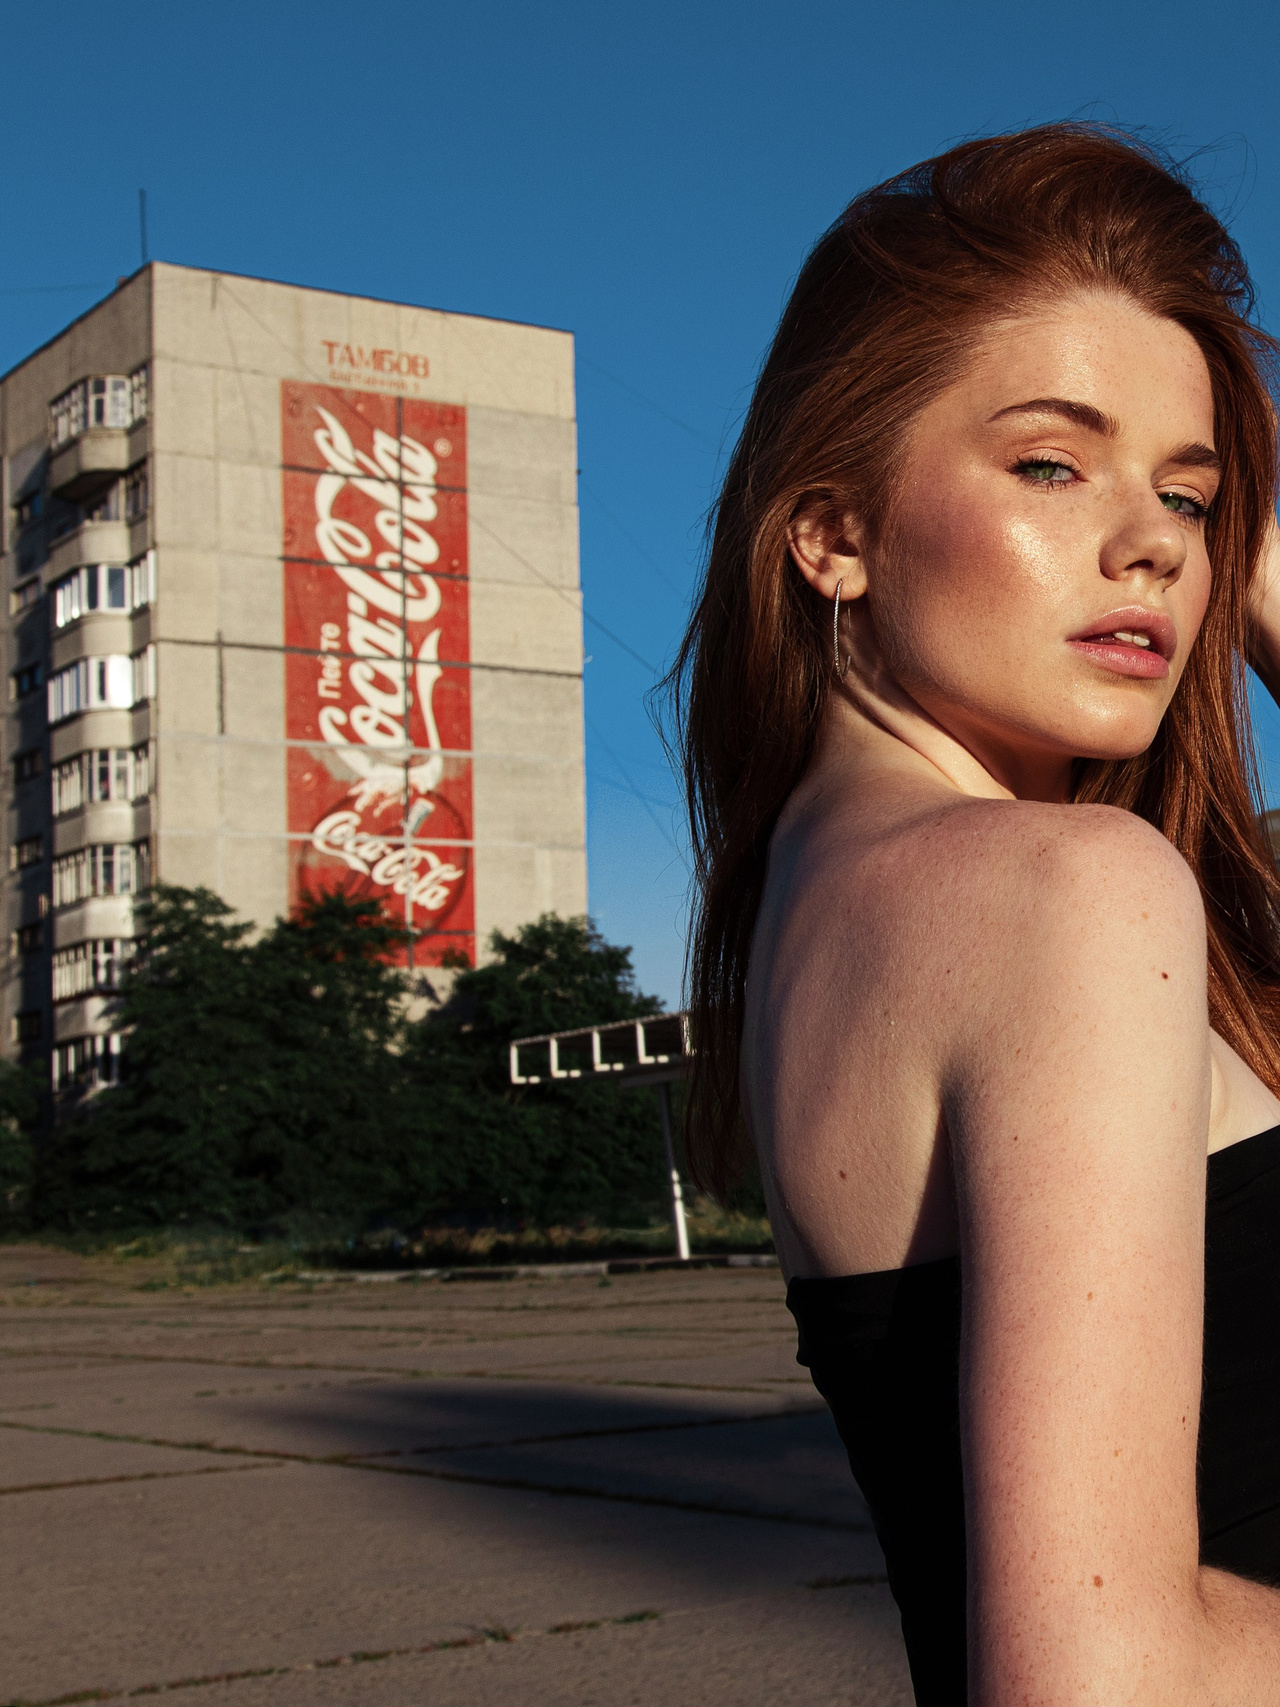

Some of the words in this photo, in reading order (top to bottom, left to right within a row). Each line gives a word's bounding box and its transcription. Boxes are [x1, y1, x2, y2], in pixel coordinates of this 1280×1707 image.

[321, 340, 430, 379] ТАМБОВ
[313, 404, 443, 790] Coca-Cola
[312, 811, 465, 911] Coca-Cola
